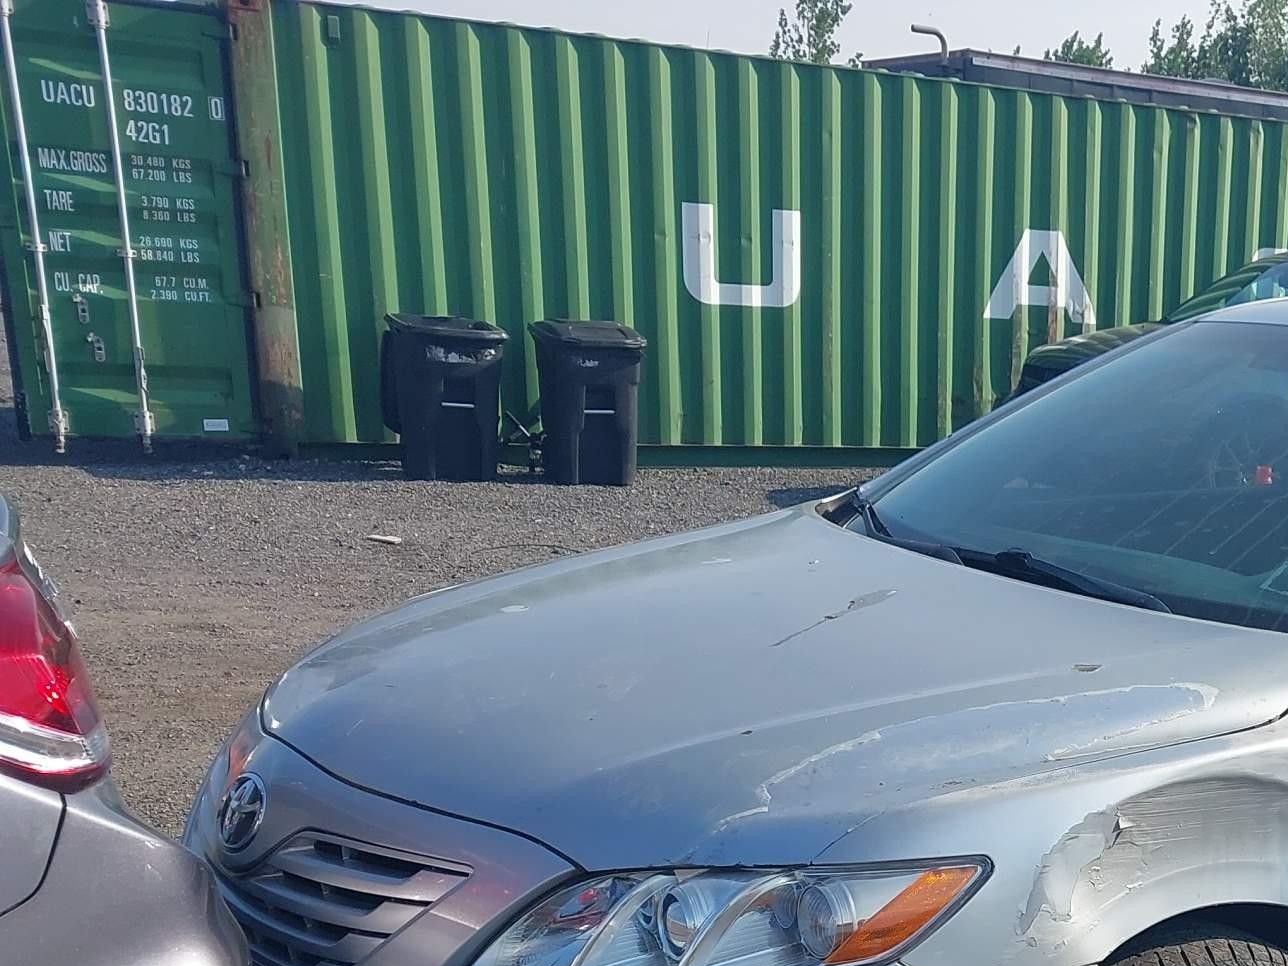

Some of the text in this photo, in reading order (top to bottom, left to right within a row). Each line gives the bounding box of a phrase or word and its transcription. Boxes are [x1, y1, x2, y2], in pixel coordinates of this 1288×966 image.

[41, 79, 223, 120] UACU 830182 0
[126, 119, 169, 145] 42G1
[171, 158, 192, 169] KGS
[173, 171, 192, 183] LBS
[43, 189, 75, 212] TARE
[176, 198, 195, 210] KGS
[176, 212, 197, 223] LBS
[48, 231, 72, 252] NET
[179, 238, 199, 249] KGS
[180, 251, 200, 263] LBS
[154, 276, 176, 288] 67.7
